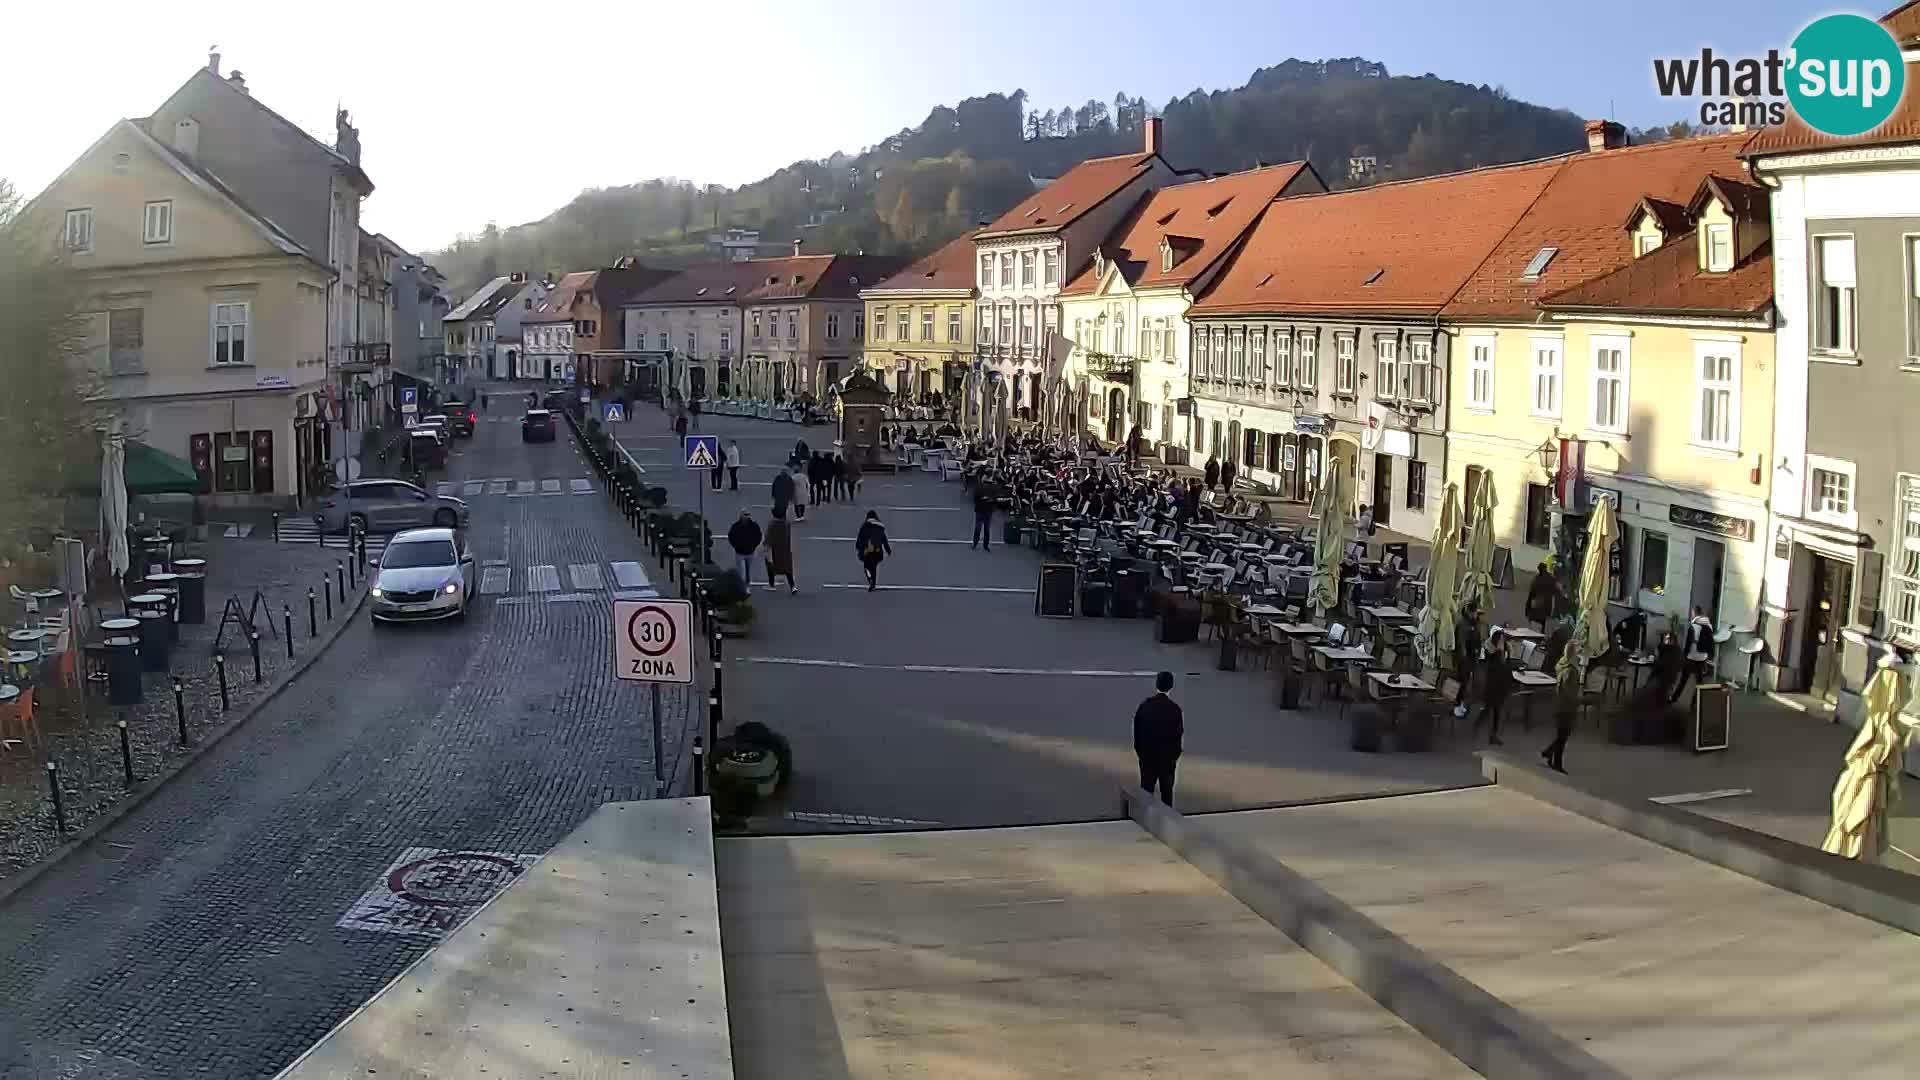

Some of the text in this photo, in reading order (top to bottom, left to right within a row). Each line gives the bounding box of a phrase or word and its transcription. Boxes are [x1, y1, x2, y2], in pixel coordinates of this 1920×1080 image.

[405, 391, 413, 402] P
[641, 621, 665, 643] 30
[631, 659, 676, 676] ZONA
